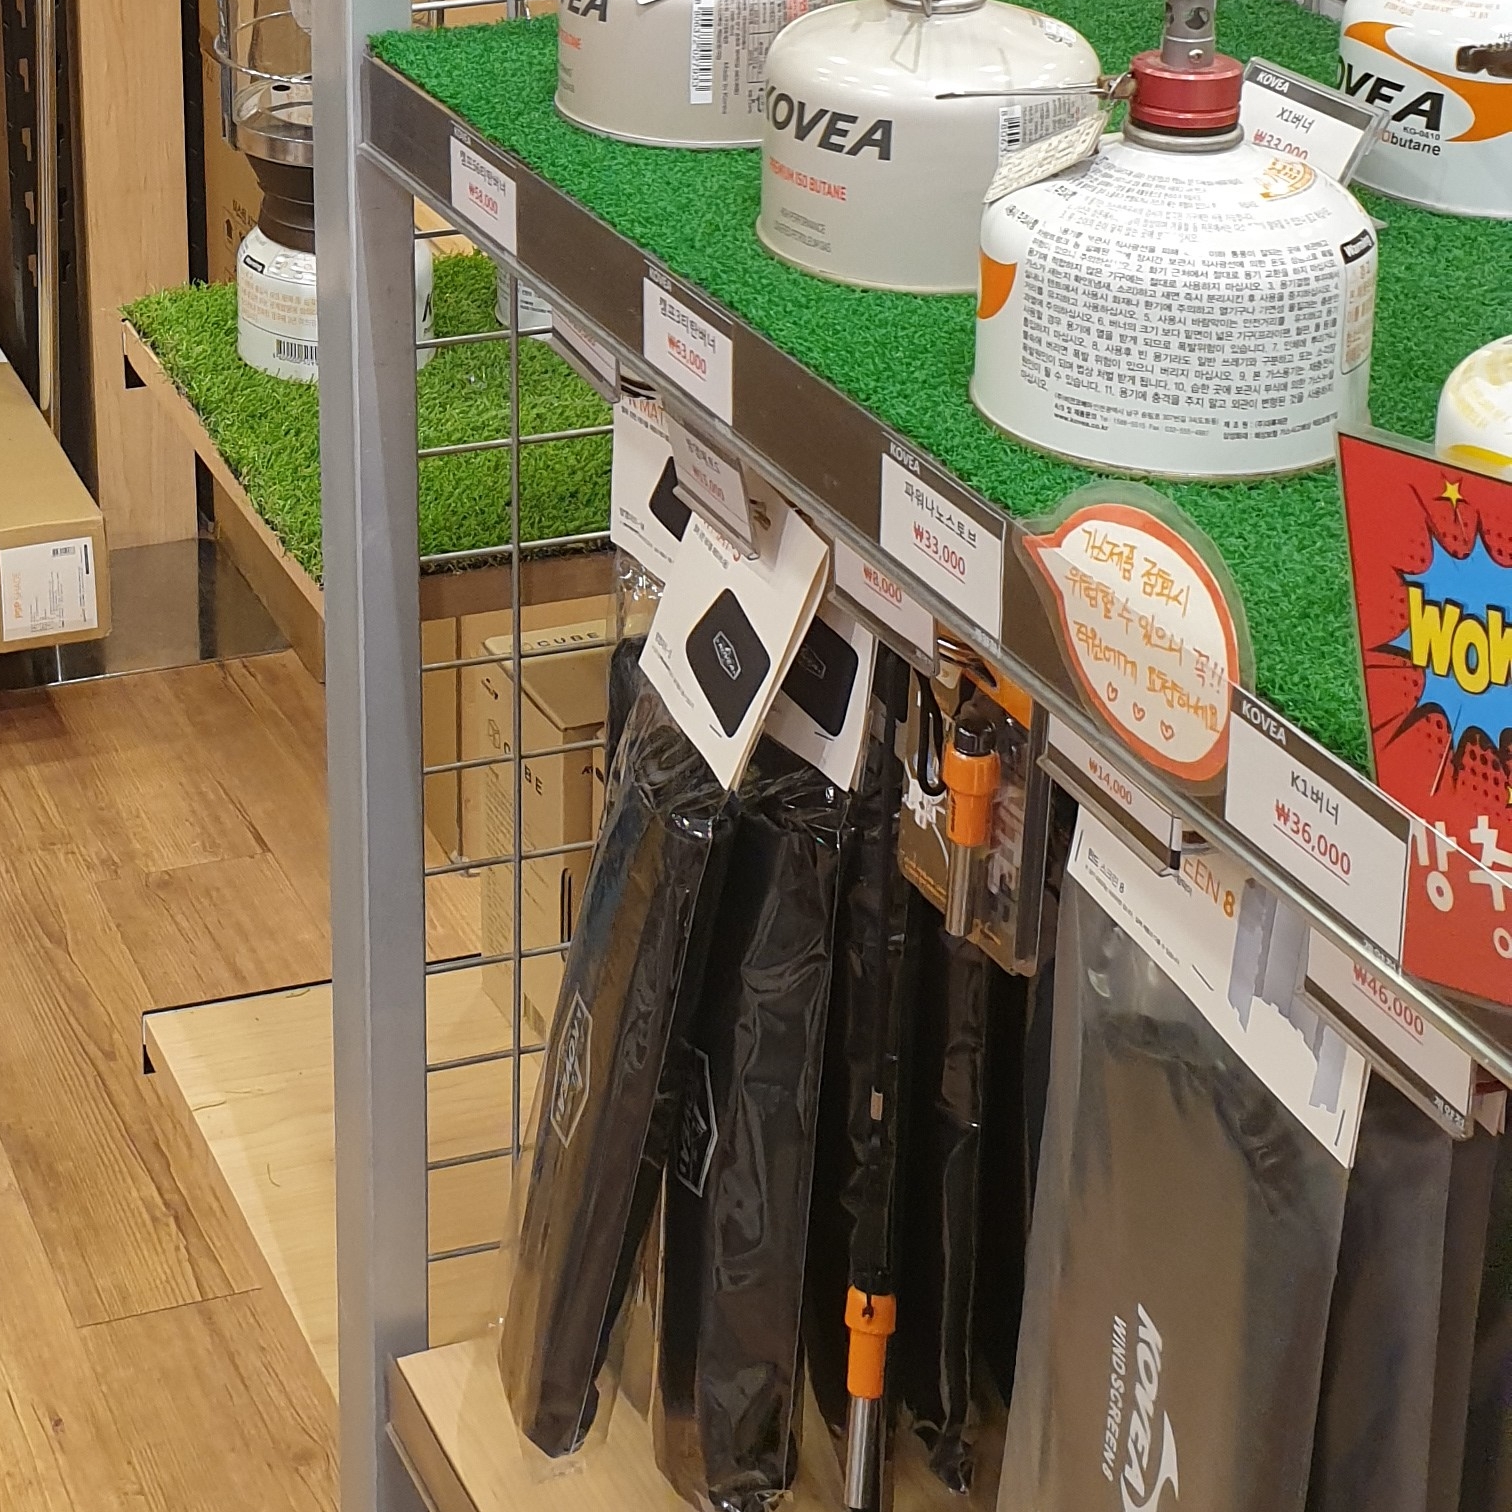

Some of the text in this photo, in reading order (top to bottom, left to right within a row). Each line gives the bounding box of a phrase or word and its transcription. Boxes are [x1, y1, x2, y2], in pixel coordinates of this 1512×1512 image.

[1256, 71, 1291, 96] KOVEA
[1276, 105, 1316, 135] X1버너
[1148, 265, 1168, 276] 화기
[1176, 302, 1214, 315] 주의하고
[1108, 319, 1181, 337] 버너의 크기 보다
[1159, 366, 1190, 379] 버리지
[1119, 387, 1227, 410] 용기에 말고
[890, 441, 921, 476] KOVEA
[903, 479, 978, 549] 파워나노스토브
[913, 520, 967, 577] ₩33,000
[863, 566, 903, 604] ₩8,000
[536, 630, 599, 649] CUBE
[1241, 699, 1288, 746] KOVEA
[1087, 754, 1133, 807] ₩14,000
[1290, 769, 1340, 826] K1버너
[1274, 798, 1352, 877] ₩36,000
[1223, 889, 1236, 919] 8
[1110, 1315, 1128, 1378] WIND
[1120, 1302, 1164, 1498] KOVEA
[1103, 1374, 1126, 1465] SCREEN
